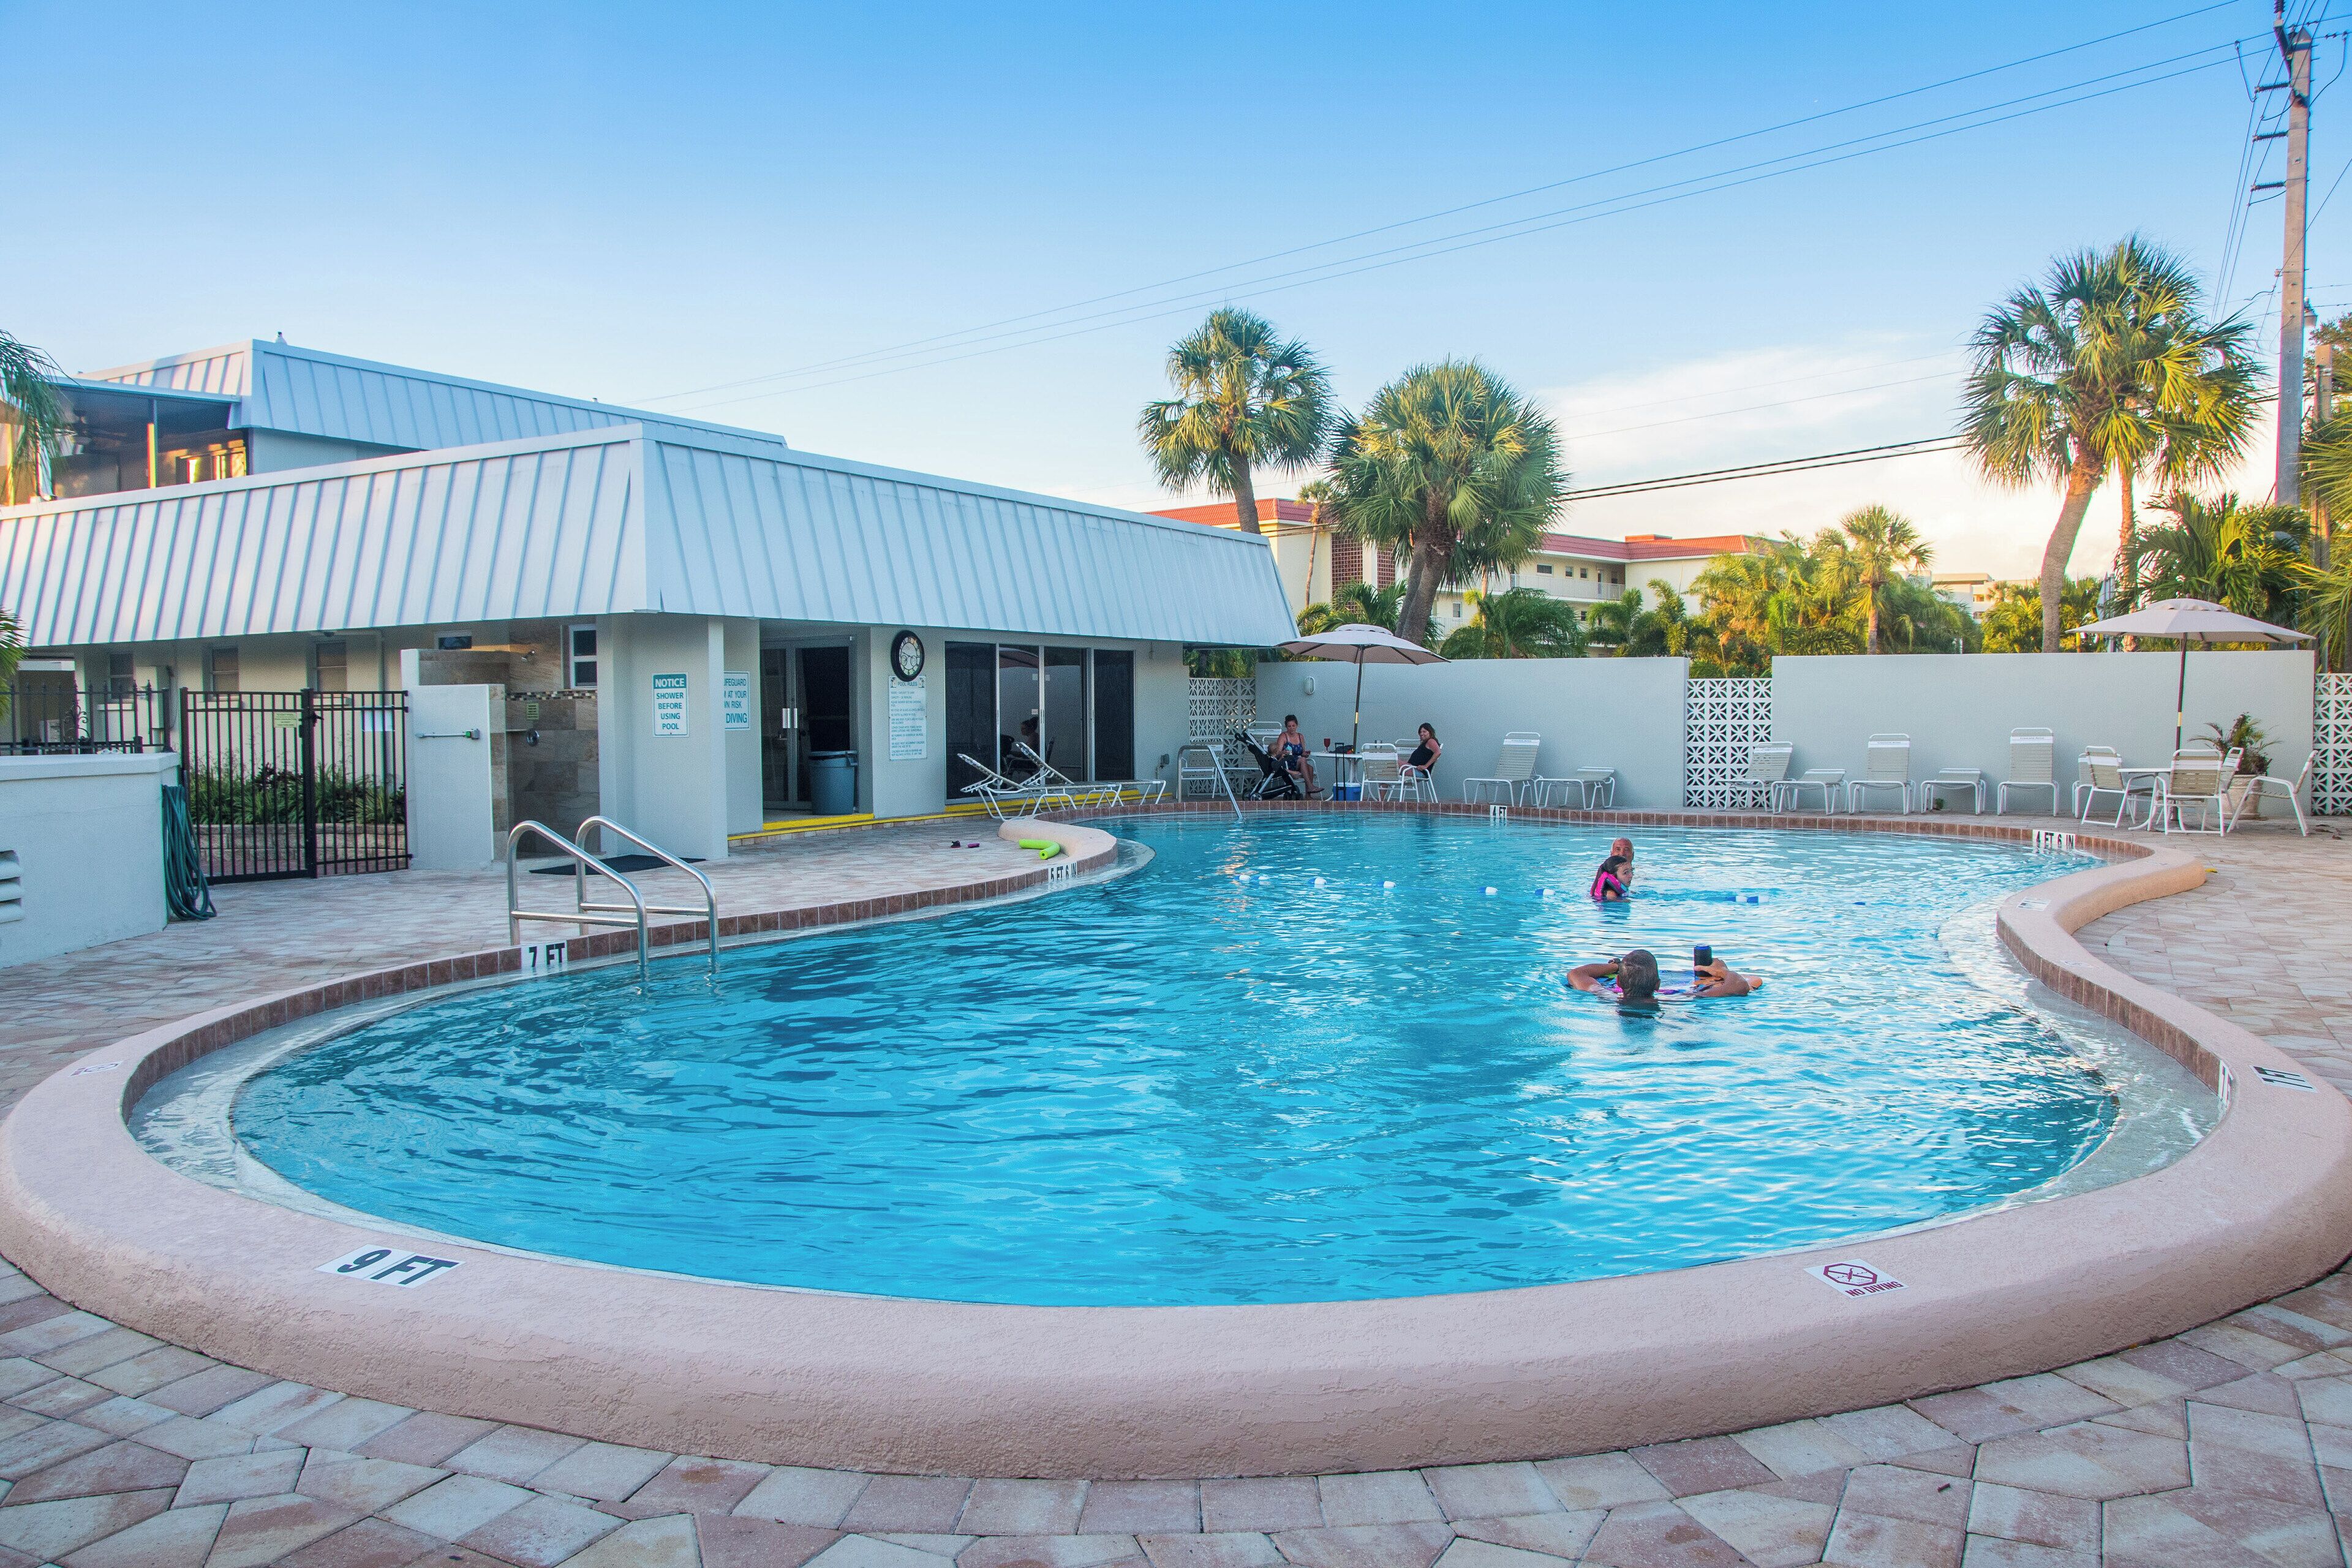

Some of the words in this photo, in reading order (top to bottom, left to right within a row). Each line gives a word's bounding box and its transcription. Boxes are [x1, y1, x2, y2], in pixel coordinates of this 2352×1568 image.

[655, 678, 685, 687] NOTICE
[726, 713, 747, 723] DIVING
[1492, 805, 1496, 816] 4
[1499, 806, 1506, 817] FT
[2036, 831, 2040, 843] 4
[2045, 832, 2054, 846] FT
[2057, 834, 2062, 846] 6
[2066, 834, 2074, 846] IN
[1057, 866, 1063, 880] FT
[529, 946, 537, 967] 7
[546, 942, 565, 965] FT
[337, 1248, 392, 1273] 9
[370, 1255, 459, 1286] FT
[1845, 1289, 1864, 1297] NO
[1863, 1281, 1904, 1294] DIVING
